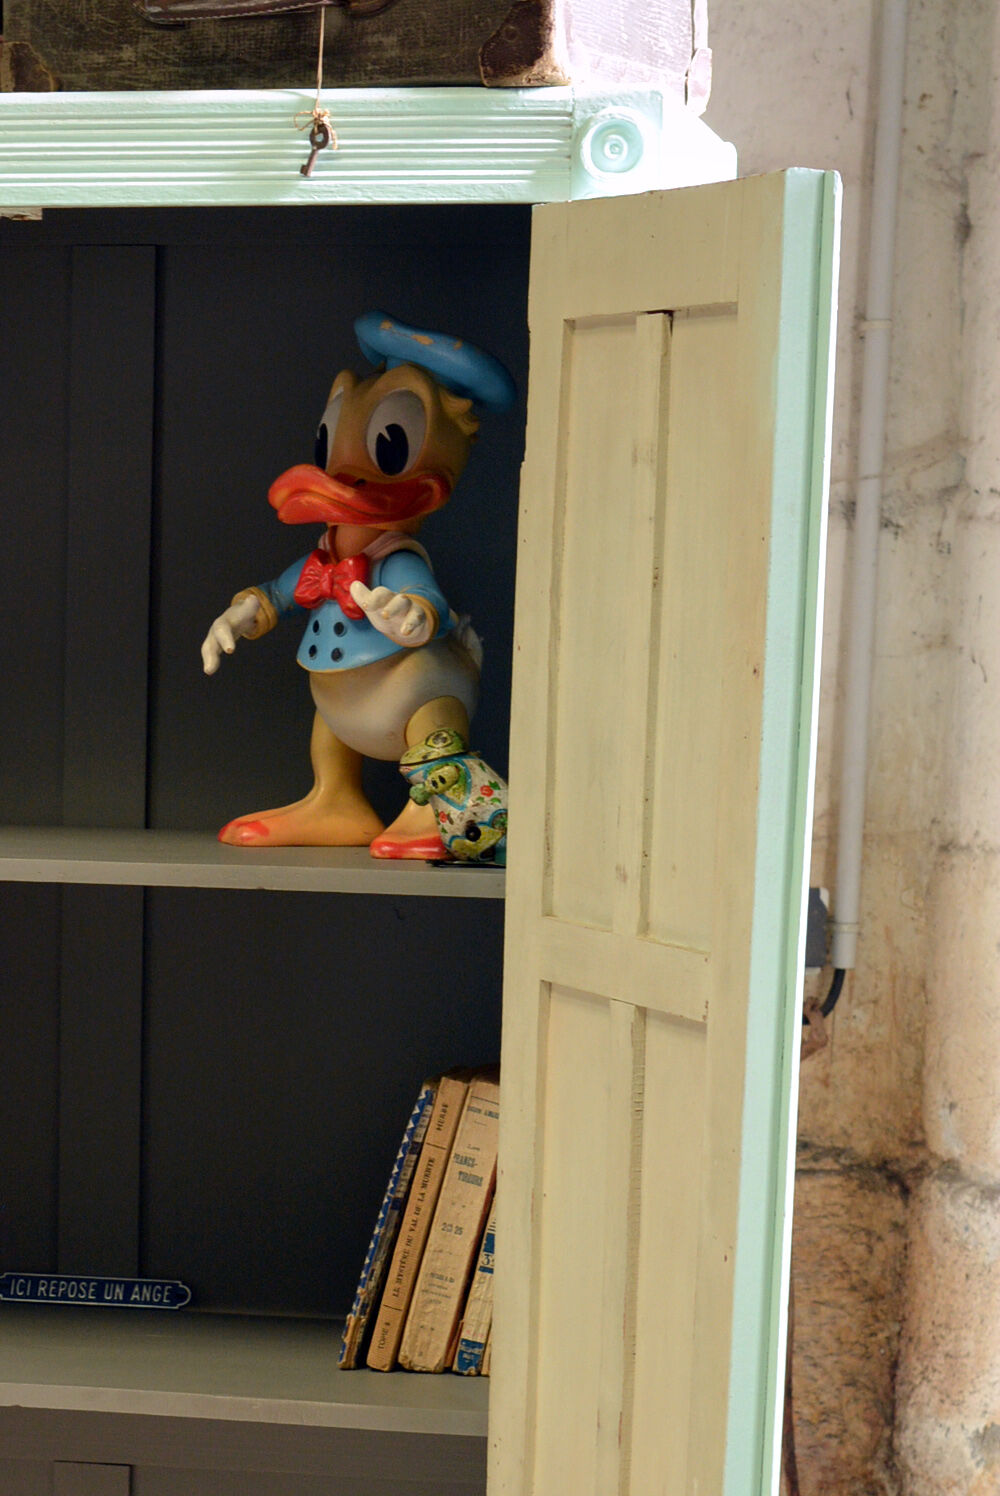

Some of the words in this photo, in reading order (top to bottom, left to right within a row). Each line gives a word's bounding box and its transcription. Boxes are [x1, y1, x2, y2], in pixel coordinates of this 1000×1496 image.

[417, 1191, 426, 1203] LA
[408, 1218, 418, 1233] VAL
[404, 1234, 414, 1247] DU
[10, 1279, 32, 1296] ICI
[37, 1280, 98, 1299] REPOSE
[104, 1283, 125, 1300] UN
[130, 1284, 172, 1303] ANGE
